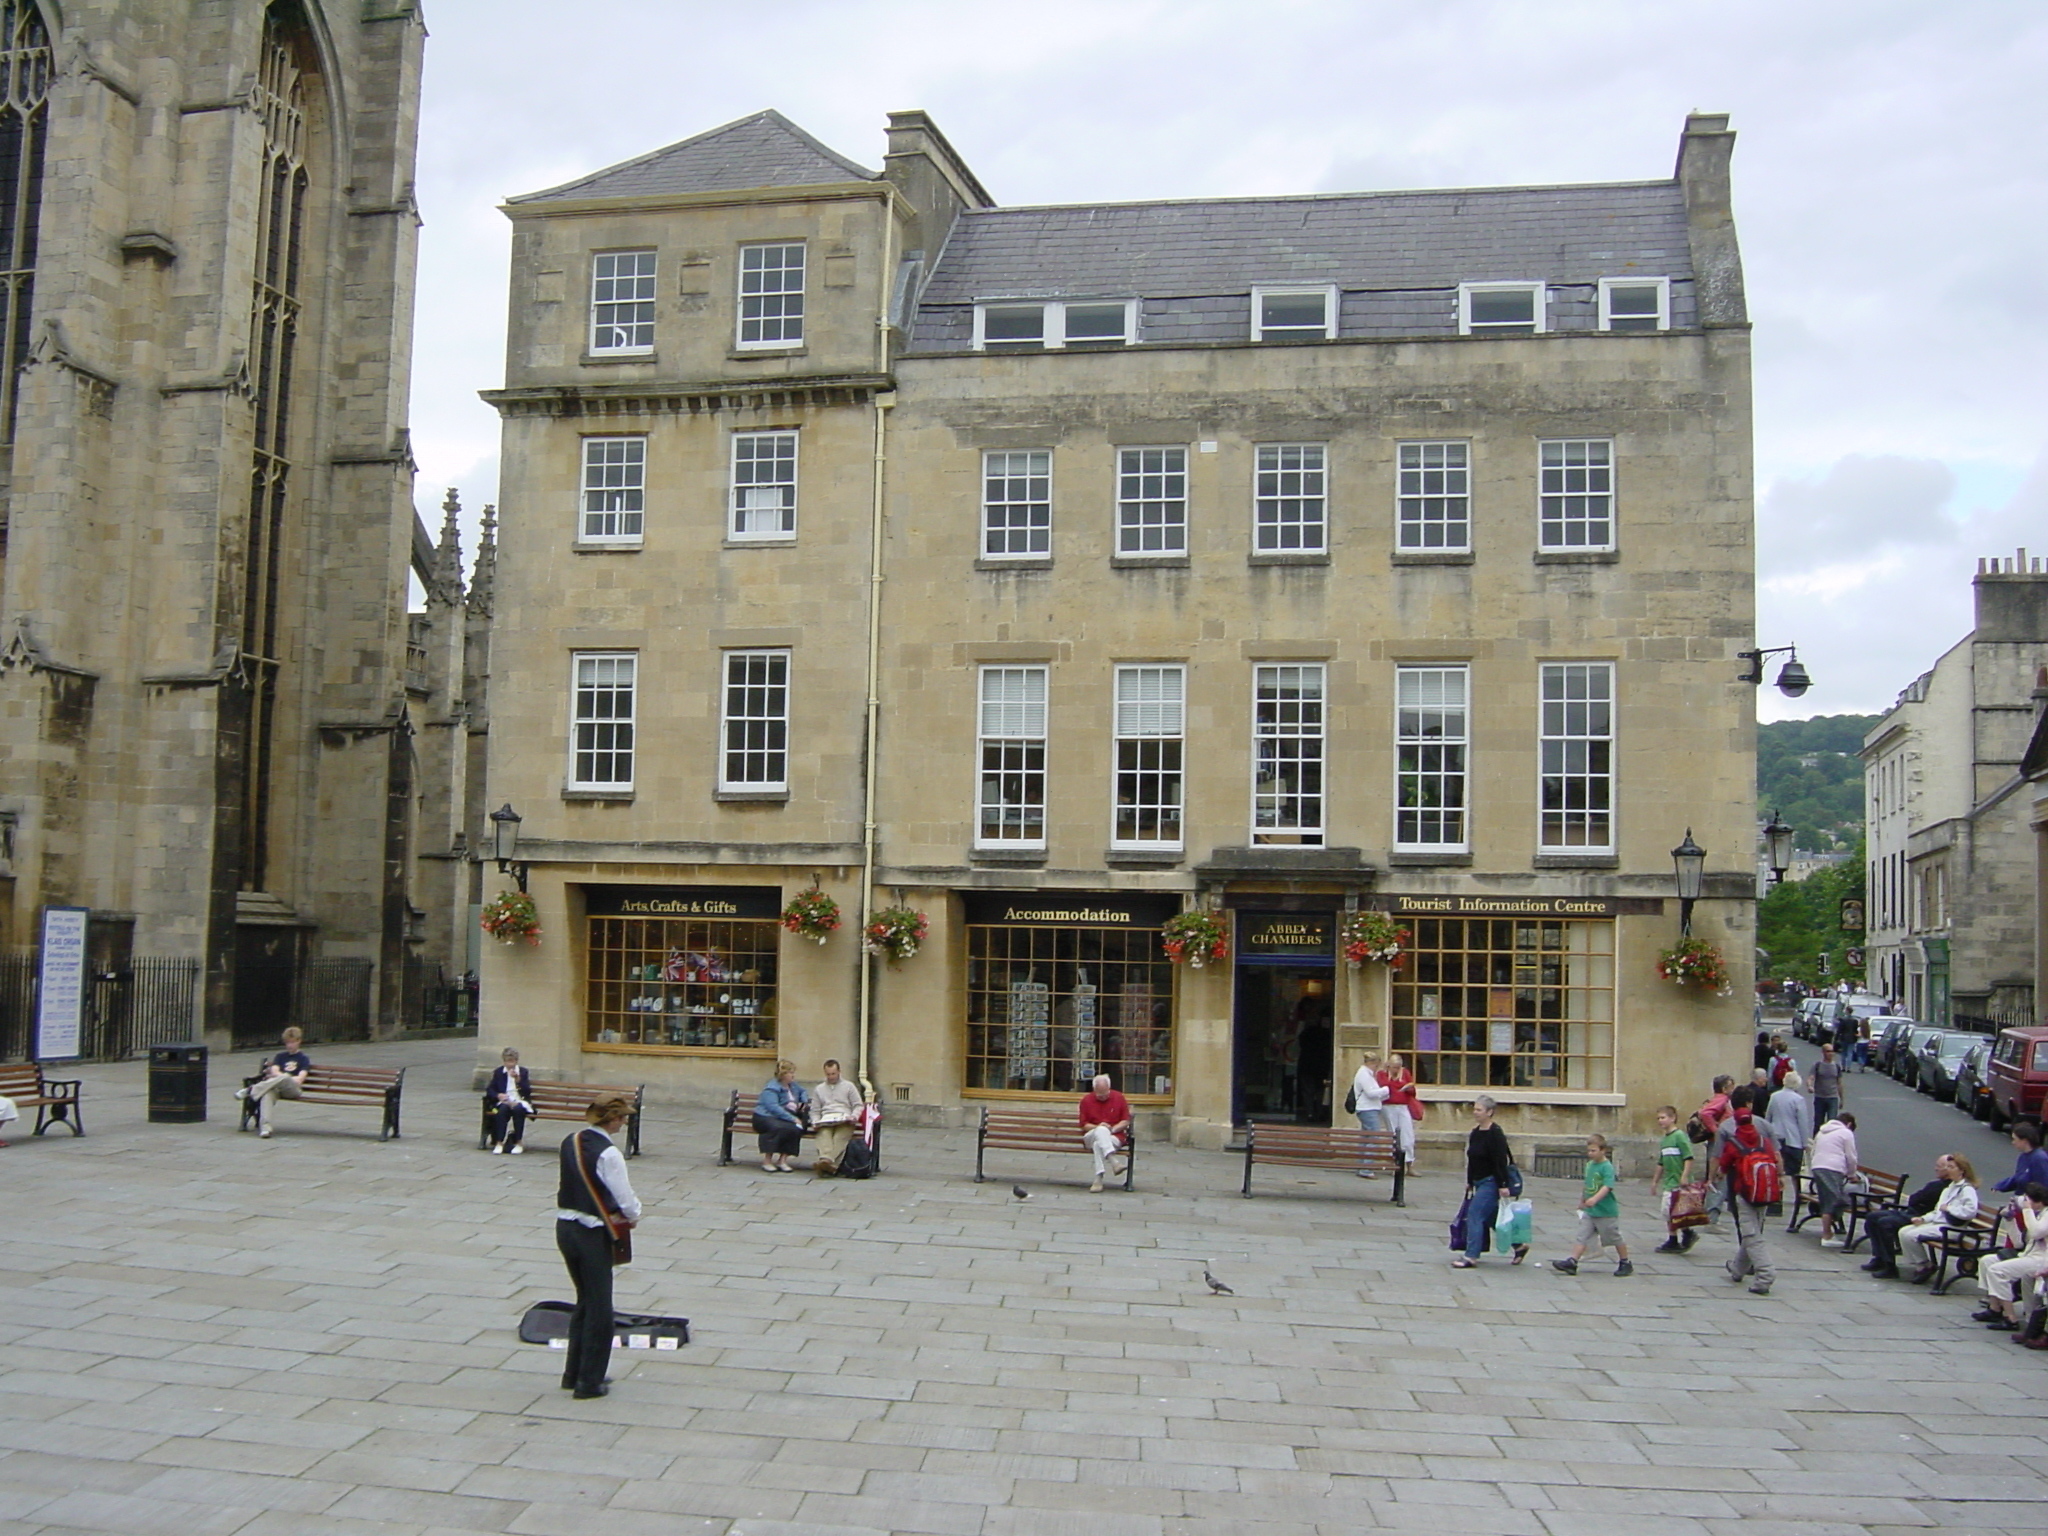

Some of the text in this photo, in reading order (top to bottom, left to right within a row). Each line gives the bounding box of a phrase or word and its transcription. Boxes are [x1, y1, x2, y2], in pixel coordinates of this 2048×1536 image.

[650, 899, 688, 913] Crafts
[690, 901, 701, 913] &
[704, 900, 737, 914] Gifts
[1399, 896, 1606, 913] Tourist Information Centre
[1004, 907, 1130, 922] Accommodation
[1266, 924, 1309, 934] ABBEY
[1251, 935, 1322, 945] CHAMBERS
